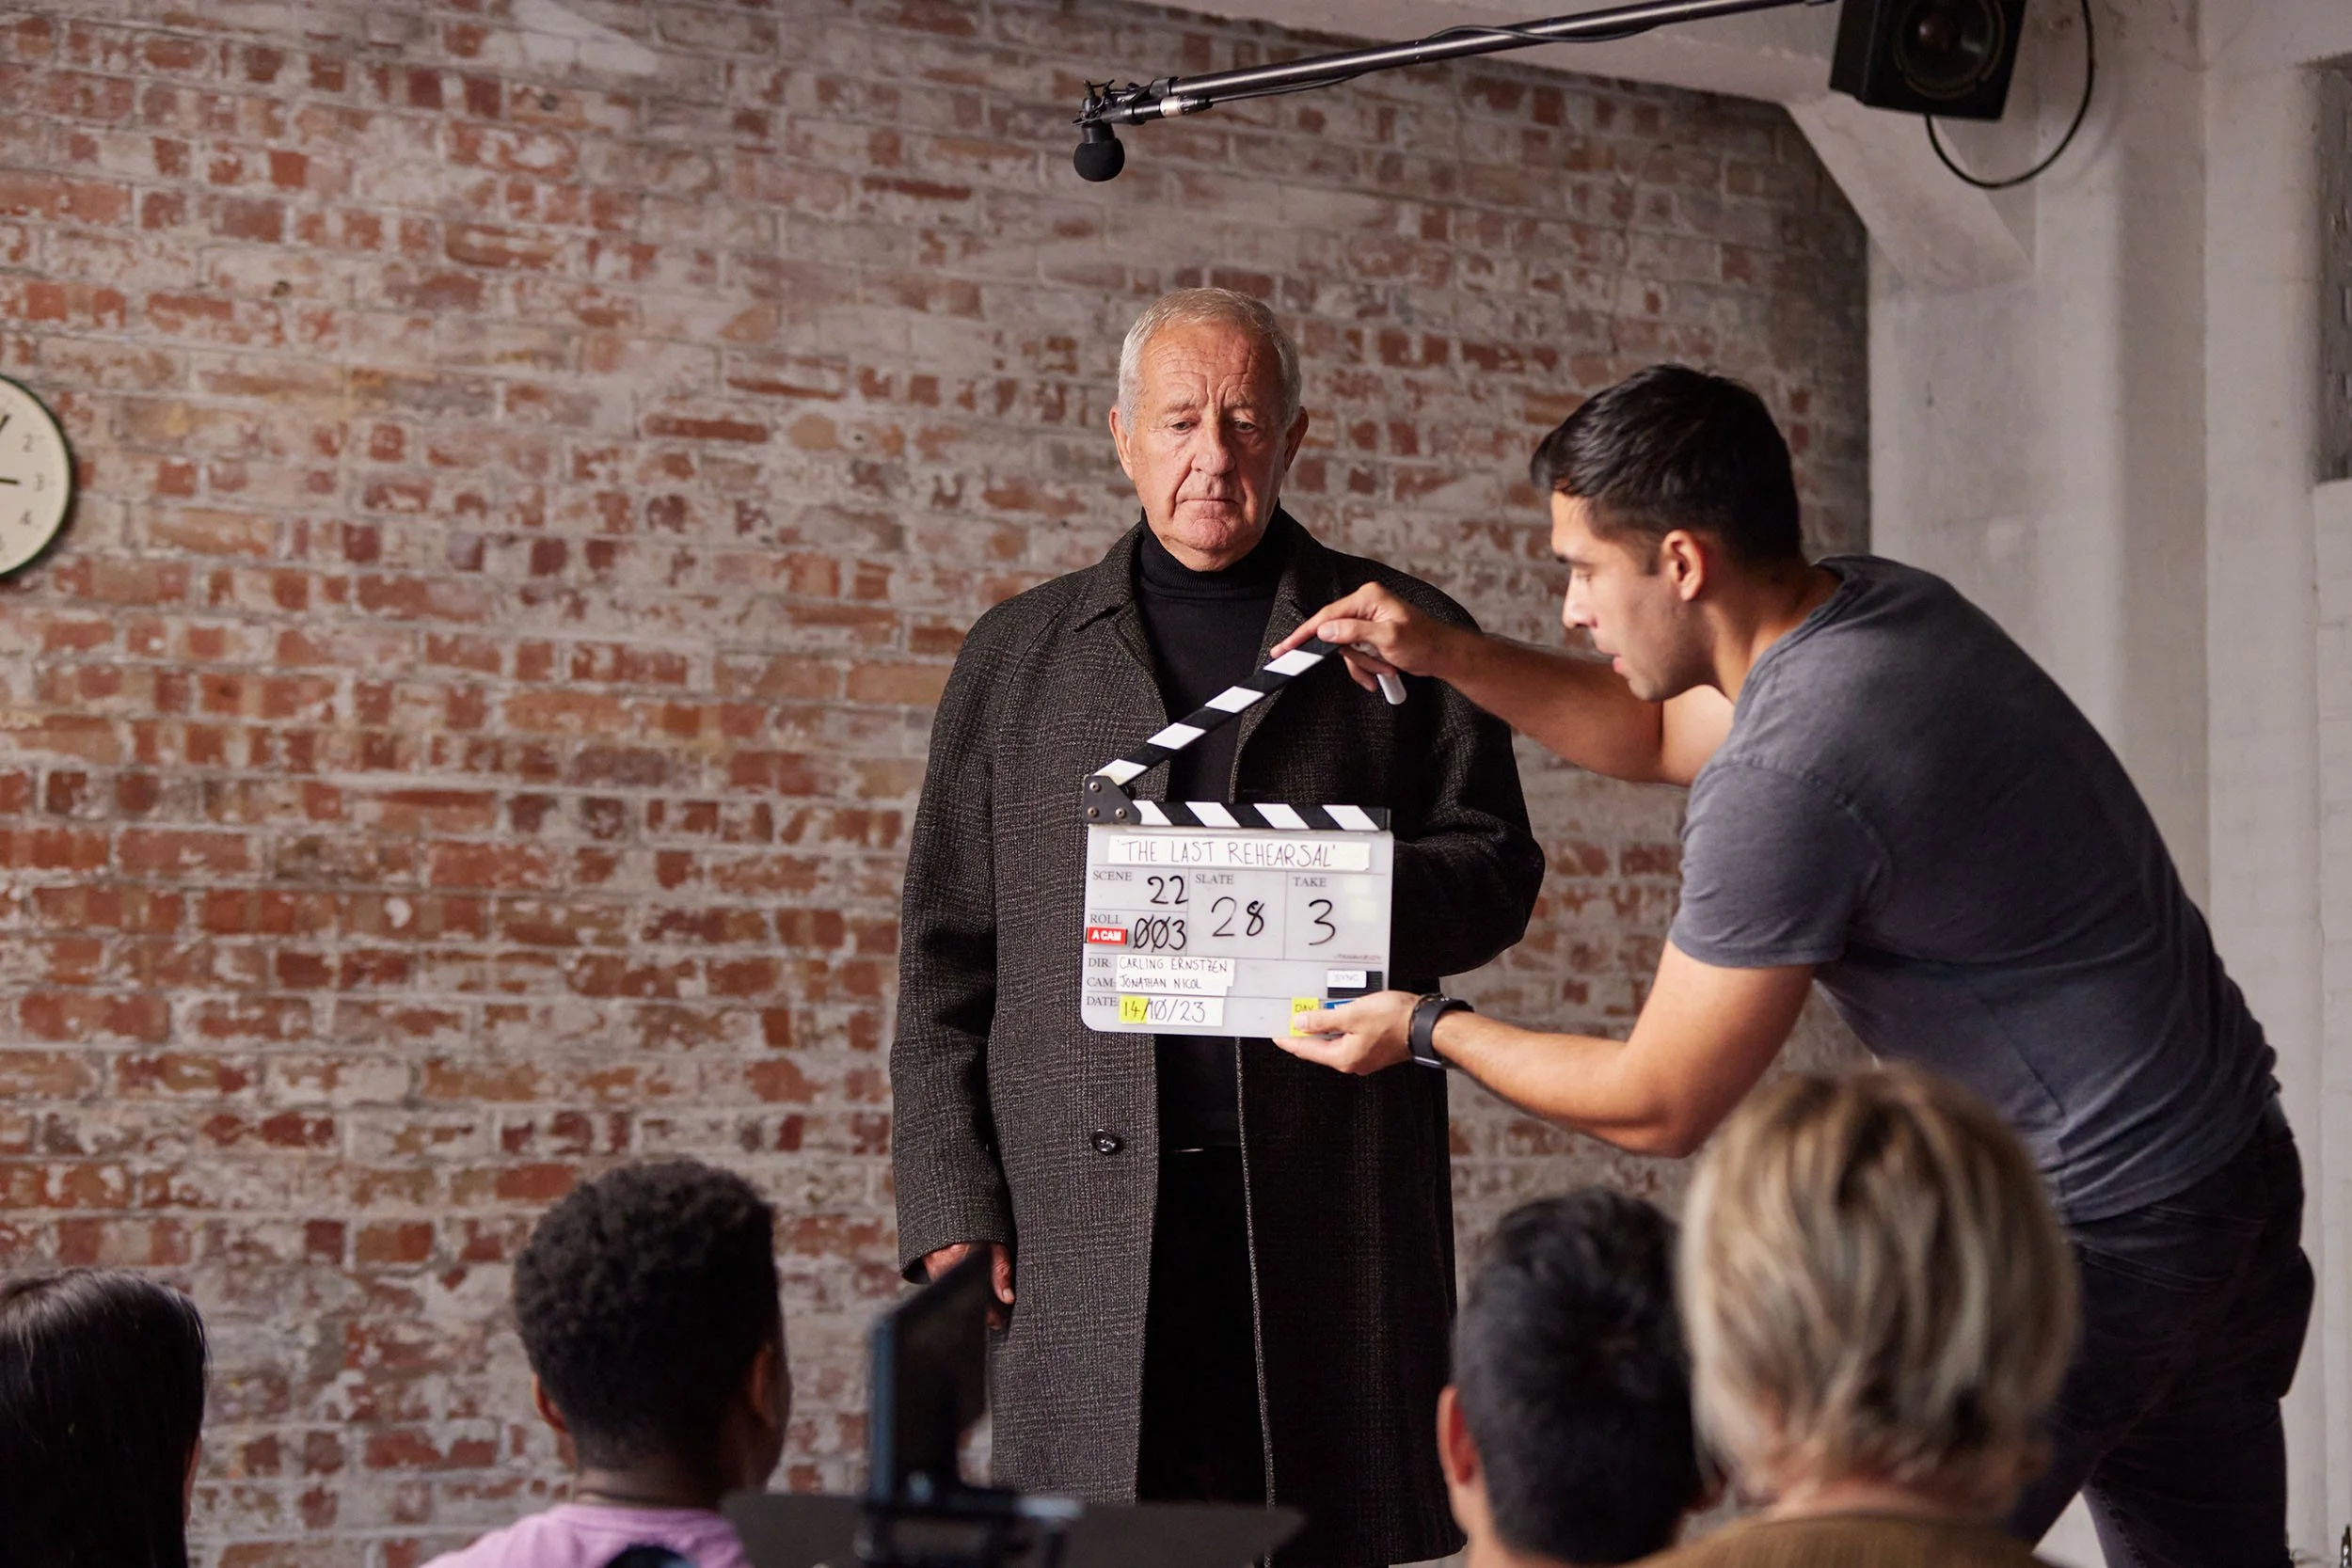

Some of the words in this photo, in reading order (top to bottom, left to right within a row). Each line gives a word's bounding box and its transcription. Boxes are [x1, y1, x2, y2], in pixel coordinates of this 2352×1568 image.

[1170, 840, 1215, 863] LAST
[1092, 871, 1133, 881] SCENE
[1195, 874, 1234, 885] SLATE
[1293, 877, 1327, 888] TAKE
[1147, 875, 1189, 905] 22
[1089, 914, 1122, 925] ROLL
[1211, 896, 1264, 937] 28
[1308, 898, 1336, 946] 3
[1091, 930, 1101, 940] A
[1102, 931, 1122, 942] CAM
[1119, 958, 1164, 970] CARLING
[1170, 958, 1228, 973] ERNSTZEN
[1120, 974, 1167, 989] JONATHAN
